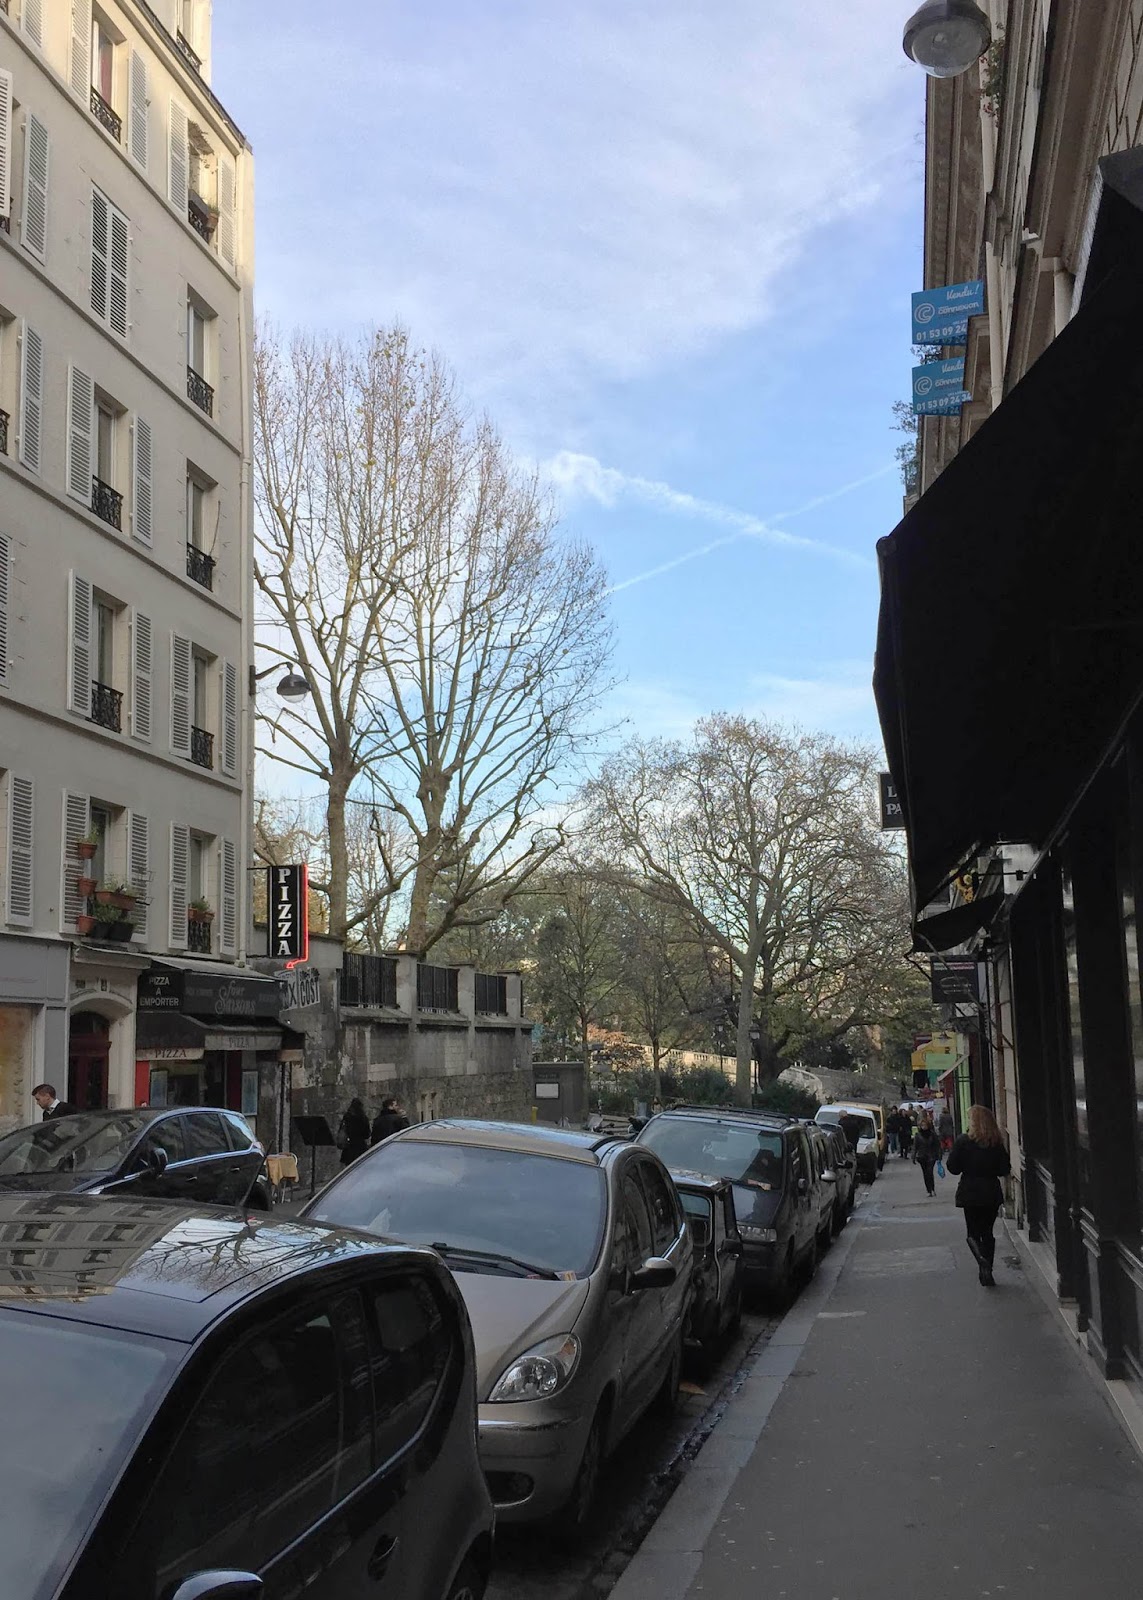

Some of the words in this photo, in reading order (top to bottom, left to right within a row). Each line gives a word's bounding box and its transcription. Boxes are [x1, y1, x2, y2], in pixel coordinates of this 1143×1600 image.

[916, 331, 926, 341] 01
[929, 328, 940, 338] 53
[942, 326, 953, 336] 09
[955, 324, 967, 334] 24
[916, 402, 926, 411] 01
[928, 399, 938, 409] 53
[939, 397, 949, 407] 09
[950, 395, 960, 405] 24
[886, 785, 898, 798] L
[885, 802, 903, 816] PA
[277, 868, 292, 956] PIZZA
[149, 976, 170, 986] PIZZA
[139, 997, 179, 1007] EMPORTER
[155, 1048, 187, 1058] PIZZA
